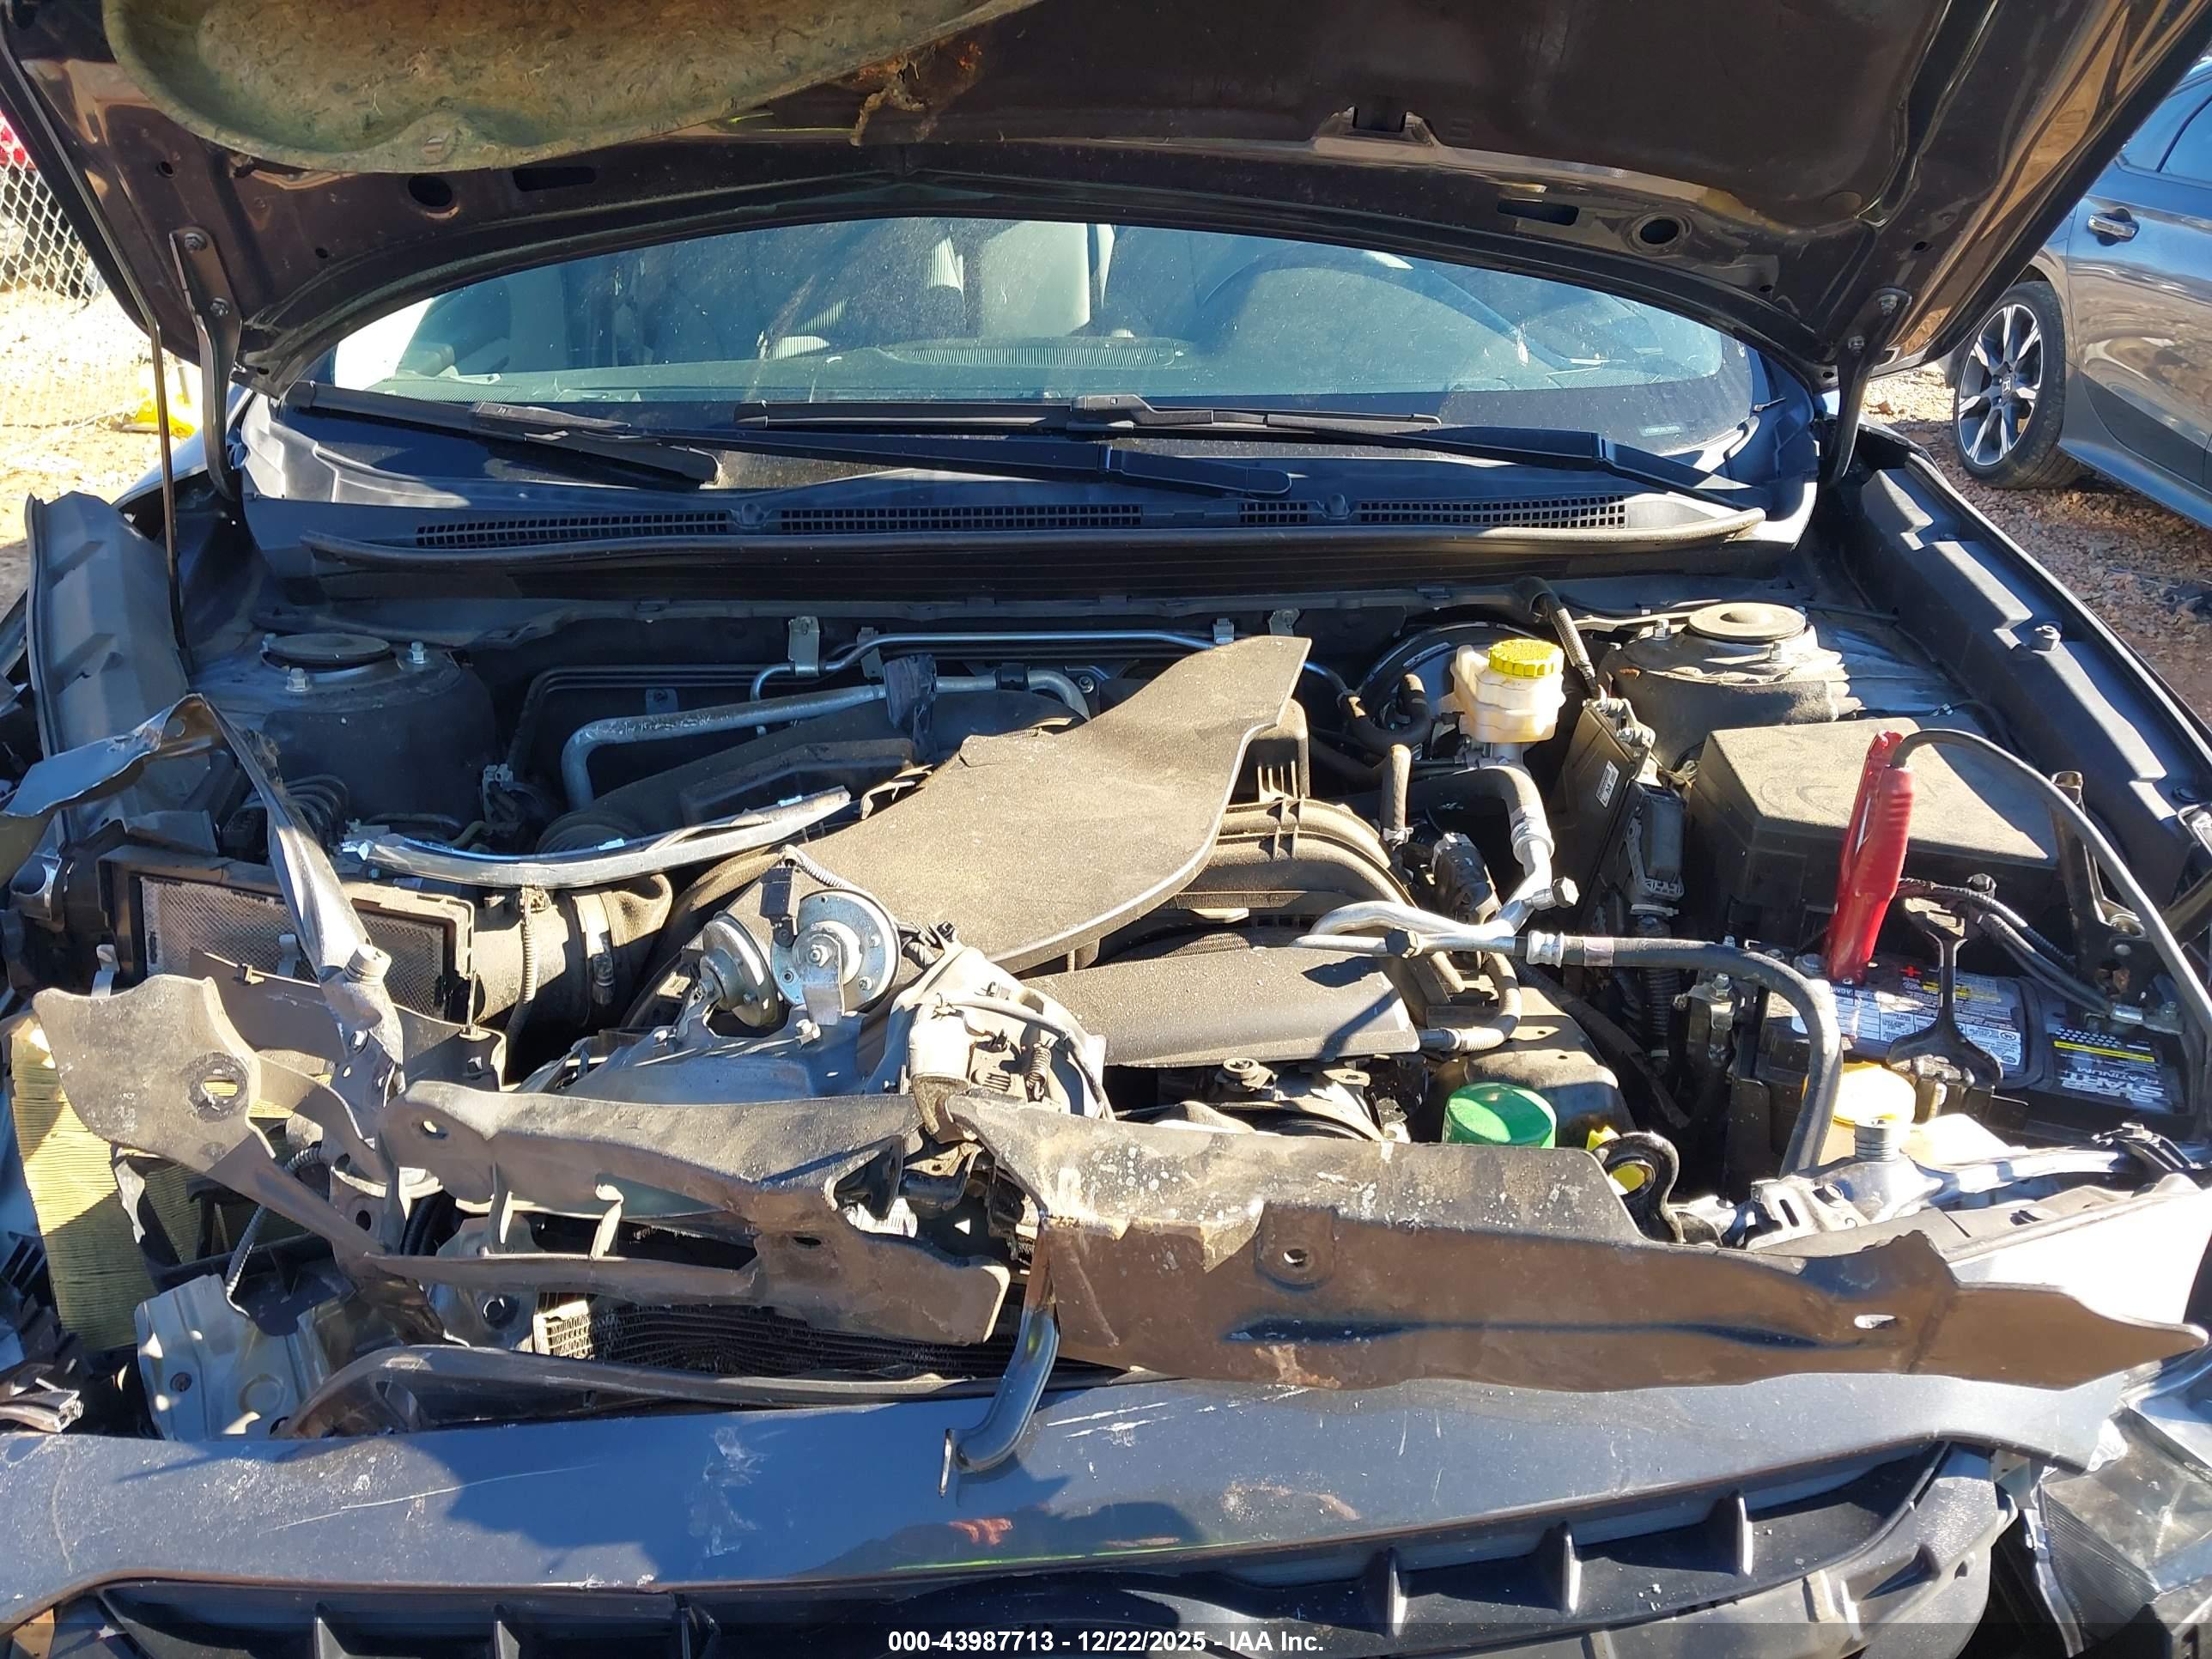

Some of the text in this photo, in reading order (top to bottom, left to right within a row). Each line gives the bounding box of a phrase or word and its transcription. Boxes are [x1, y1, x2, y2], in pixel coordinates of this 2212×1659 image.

[2061, 1072, 2165, 1098] START
[2077, 1067, 2160, 1085] PLATINUM
[2062, 1079, 2154, 1103] SUPER
